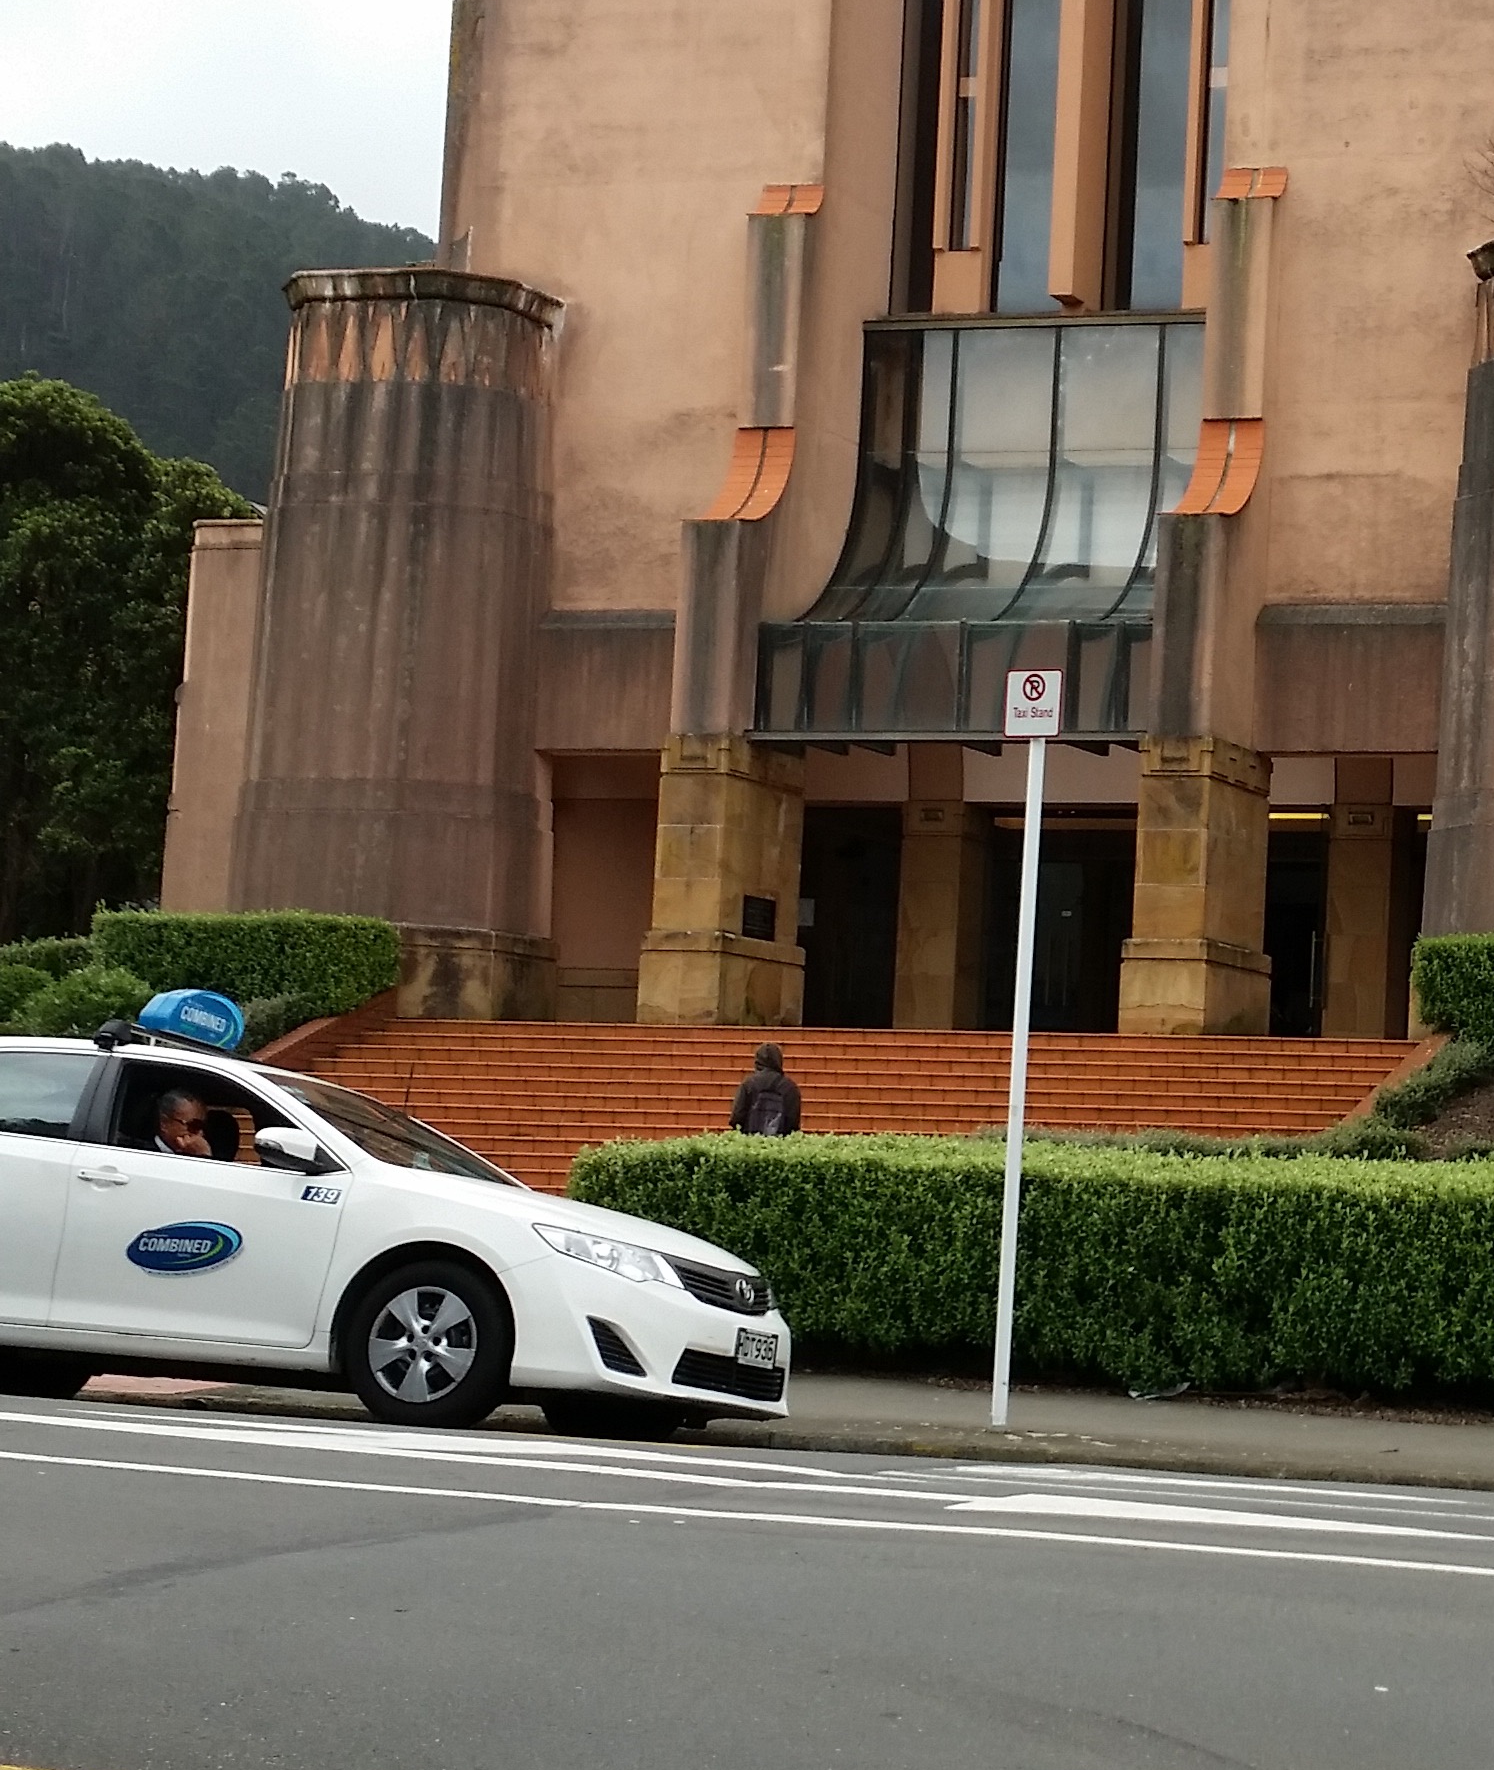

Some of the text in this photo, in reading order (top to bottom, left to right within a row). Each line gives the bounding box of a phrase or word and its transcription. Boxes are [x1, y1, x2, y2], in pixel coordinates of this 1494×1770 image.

[1013, 706, 1053, 718] Taxi Stand
[180, 1005, 227, 1032] COMBINED
[306, 1187, 339, 1203] 139
[138, 1237, 212, 1254] COMBINED
[737, 1333, 774, 1361] HDT936
